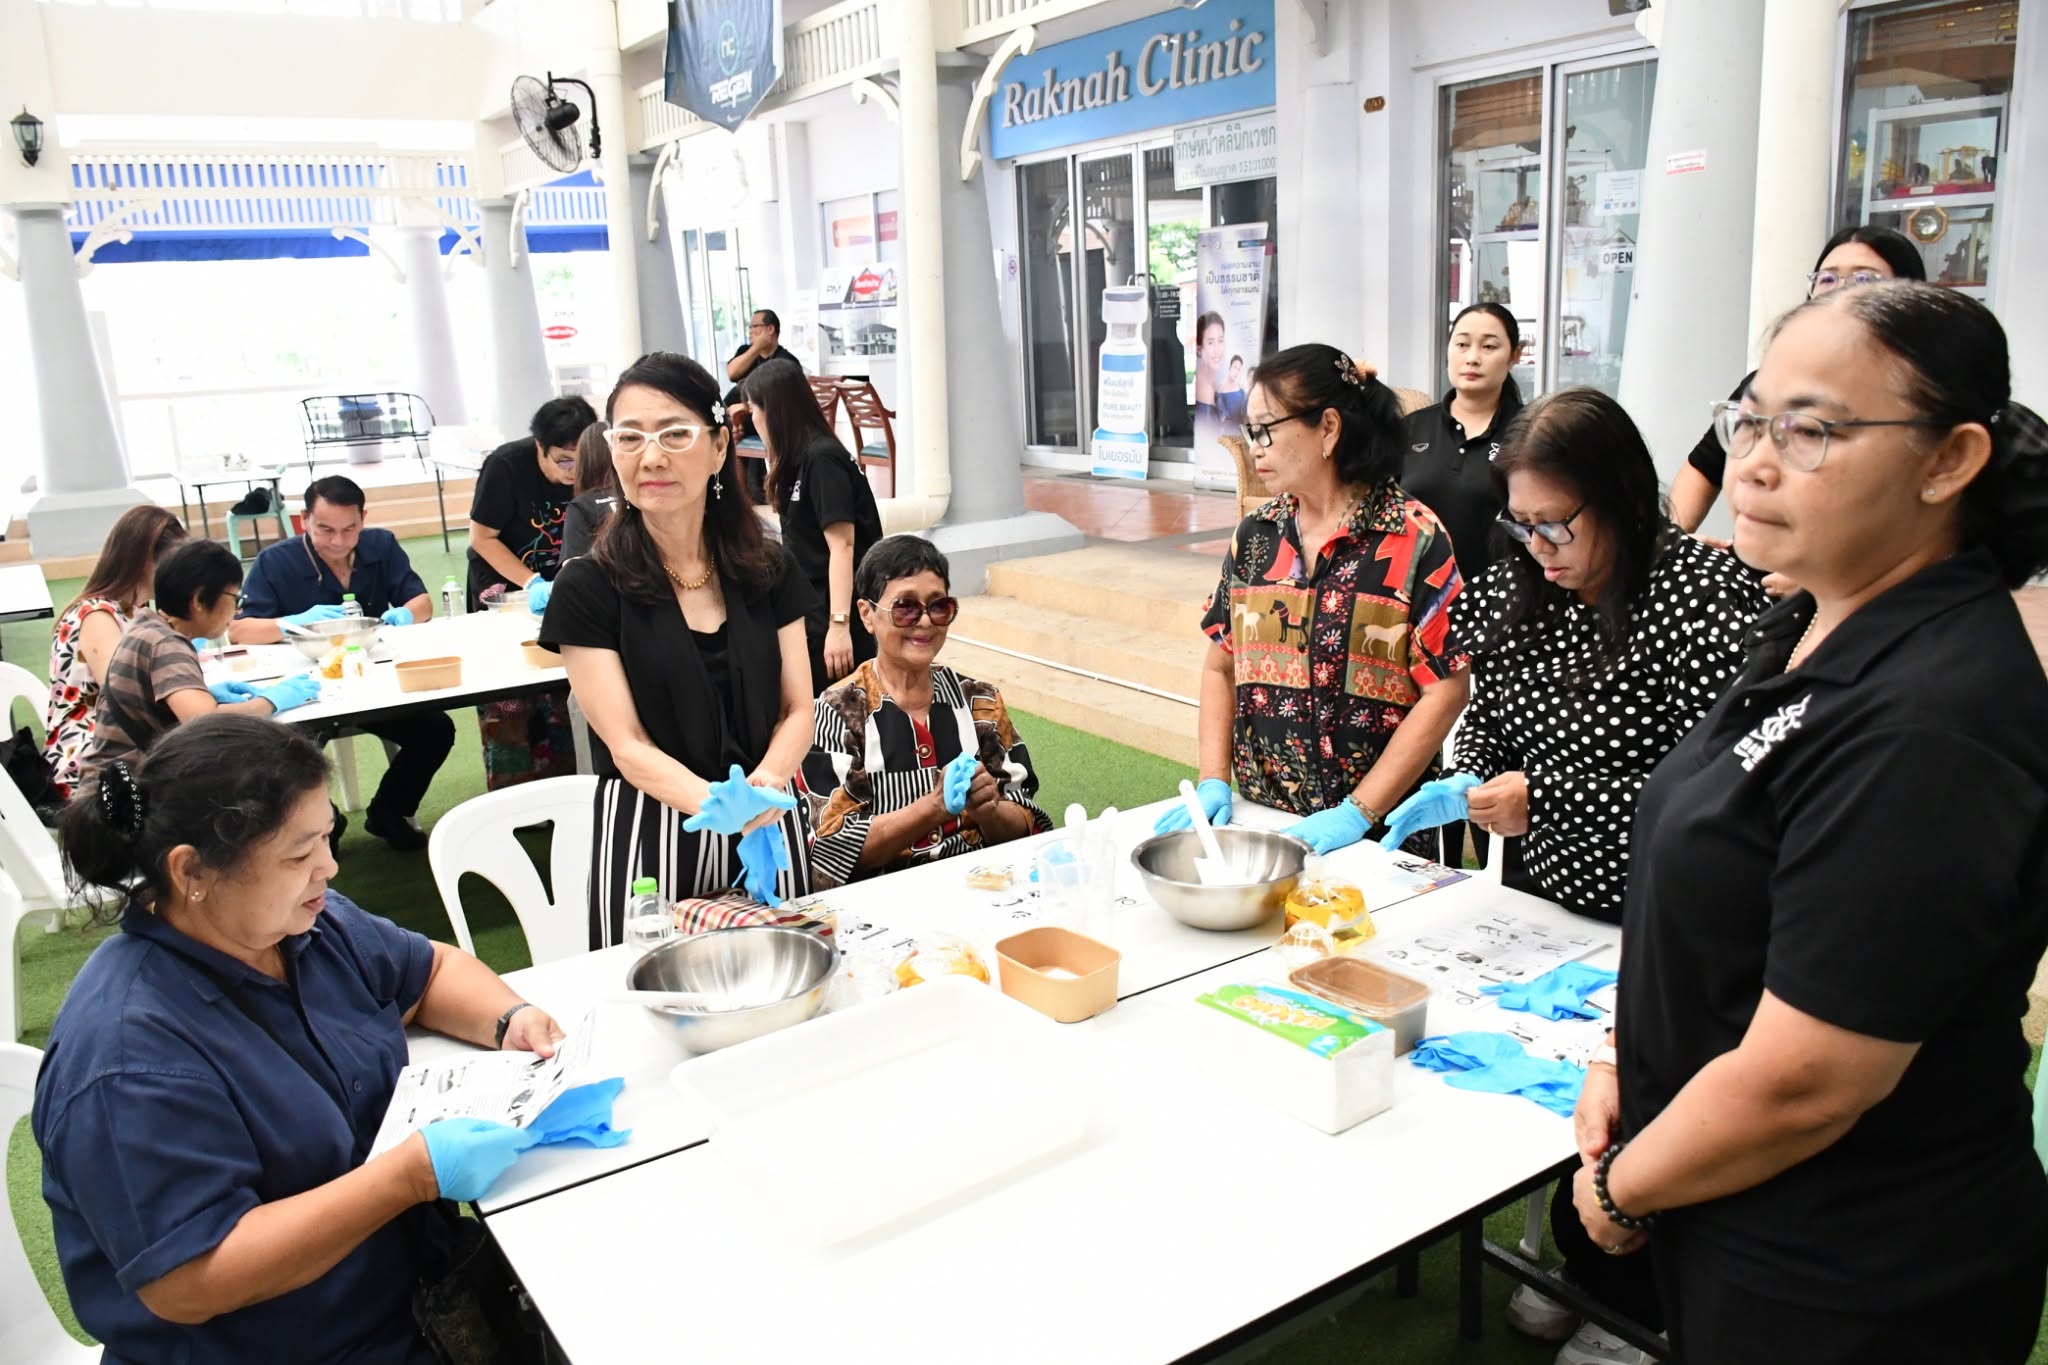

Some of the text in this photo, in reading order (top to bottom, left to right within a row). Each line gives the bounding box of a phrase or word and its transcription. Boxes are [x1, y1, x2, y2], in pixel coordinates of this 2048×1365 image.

[1002, 18, 1266, 128] Raknah Clinic
[1603, 251, 1633, 265] OPEN
[1206, 270, 1260, 285] เป็นธรรมชาติ
